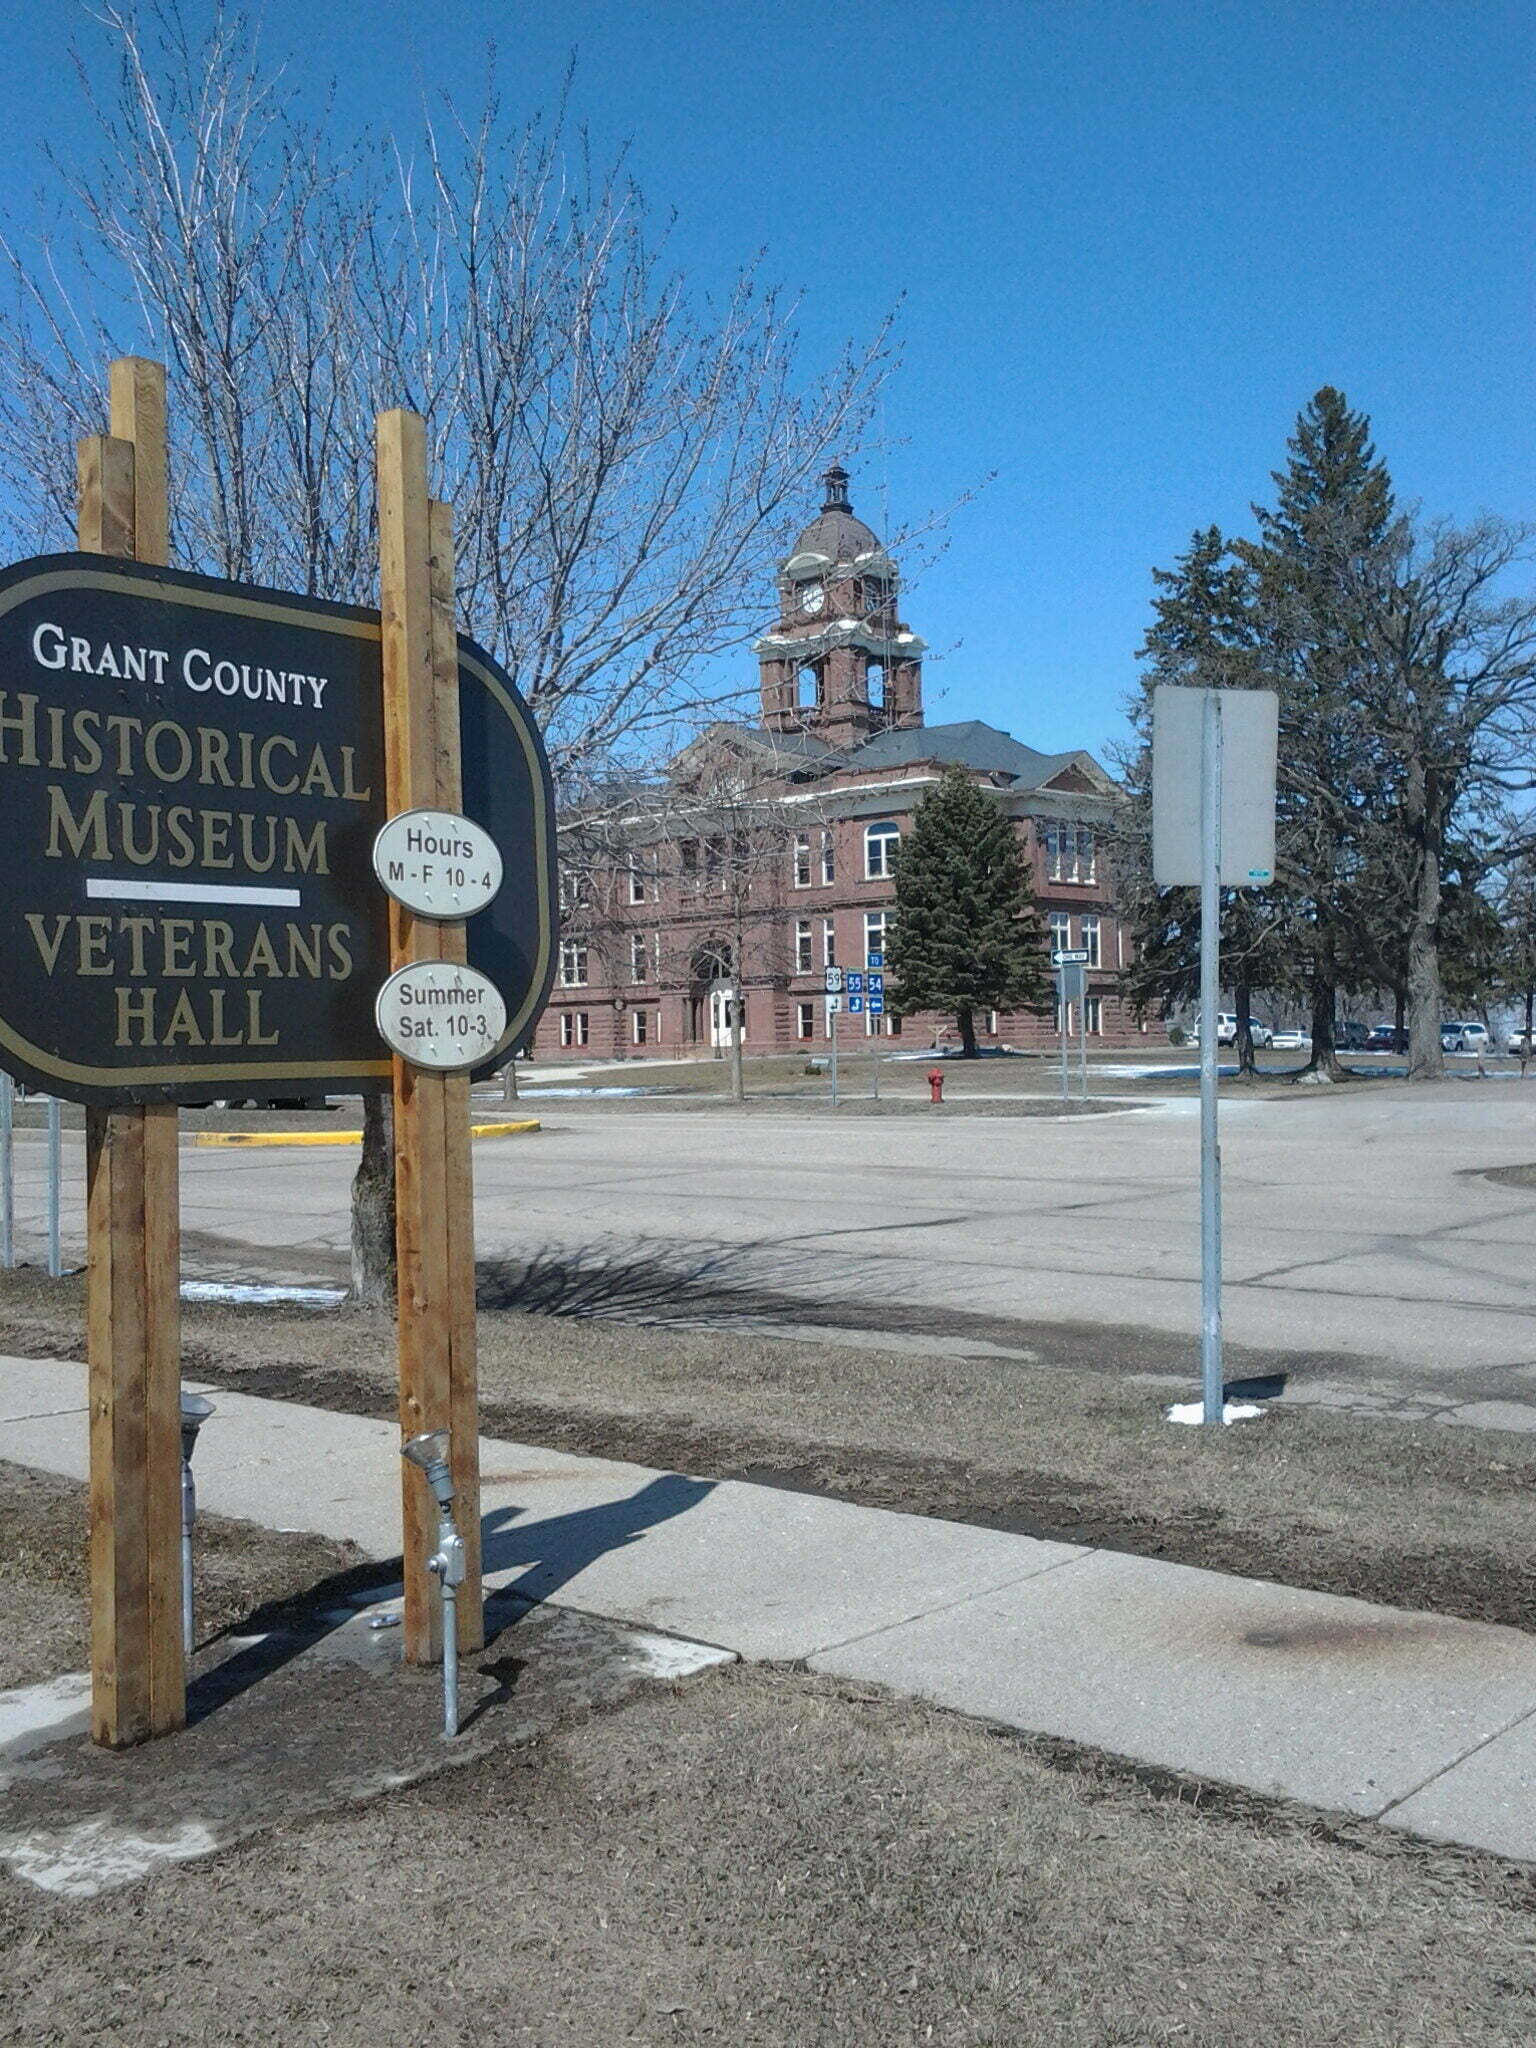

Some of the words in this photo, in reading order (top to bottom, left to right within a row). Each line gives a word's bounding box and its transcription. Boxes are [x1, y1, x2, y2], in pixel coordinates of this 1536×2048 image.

[33, 622, 169, 685] GRANT
[182, 648, 328, 709] COUNTY
[0, 690, 372, 802] HISTORICAL
[45, 785, 331, 875] MUSEUM
[407, 828, 473, 859] Hours
[24, 912, 353, 981] VETERANS
[399, 984, 485, 1005] Summer
[828, 973, 839, 985] 59
[849, 977, 861, 990] 55
[869, 977, 881, 991] 54
[114, 986, 280, 1047] HALL
[400, 1016, 439, 1038] Sat.
[447, 1014, 487, 1036] 10-3
